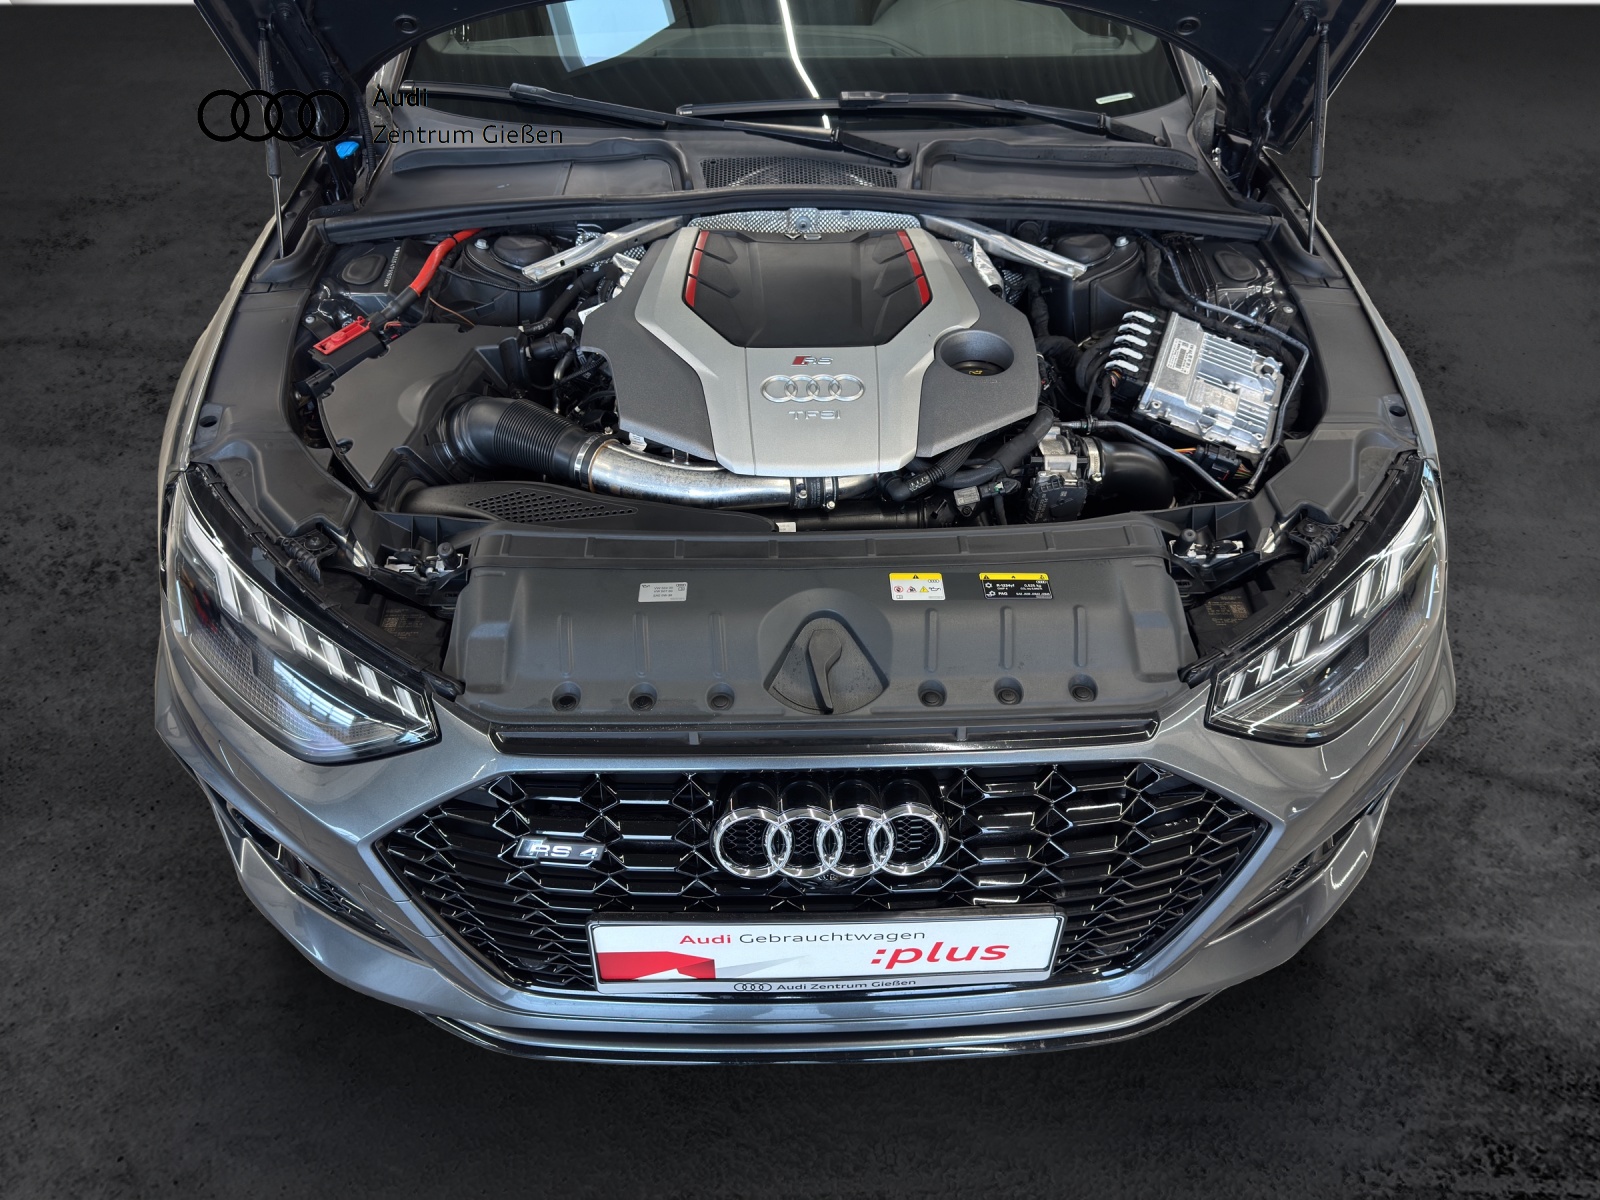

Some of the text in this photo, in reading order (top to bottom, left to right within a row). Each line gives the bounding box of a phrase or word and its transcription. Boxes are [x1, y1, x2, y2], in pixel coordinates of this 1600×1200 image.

[799, 356, 834, 366] RS
[788, 410, 841, 420] TFSI
[529, 843, 599, 860] RS 4
[679, 931, 925, 945] Audi Gebrauchtwagen
[776, 979, 917, 991] Audi Zentrum Gießen
